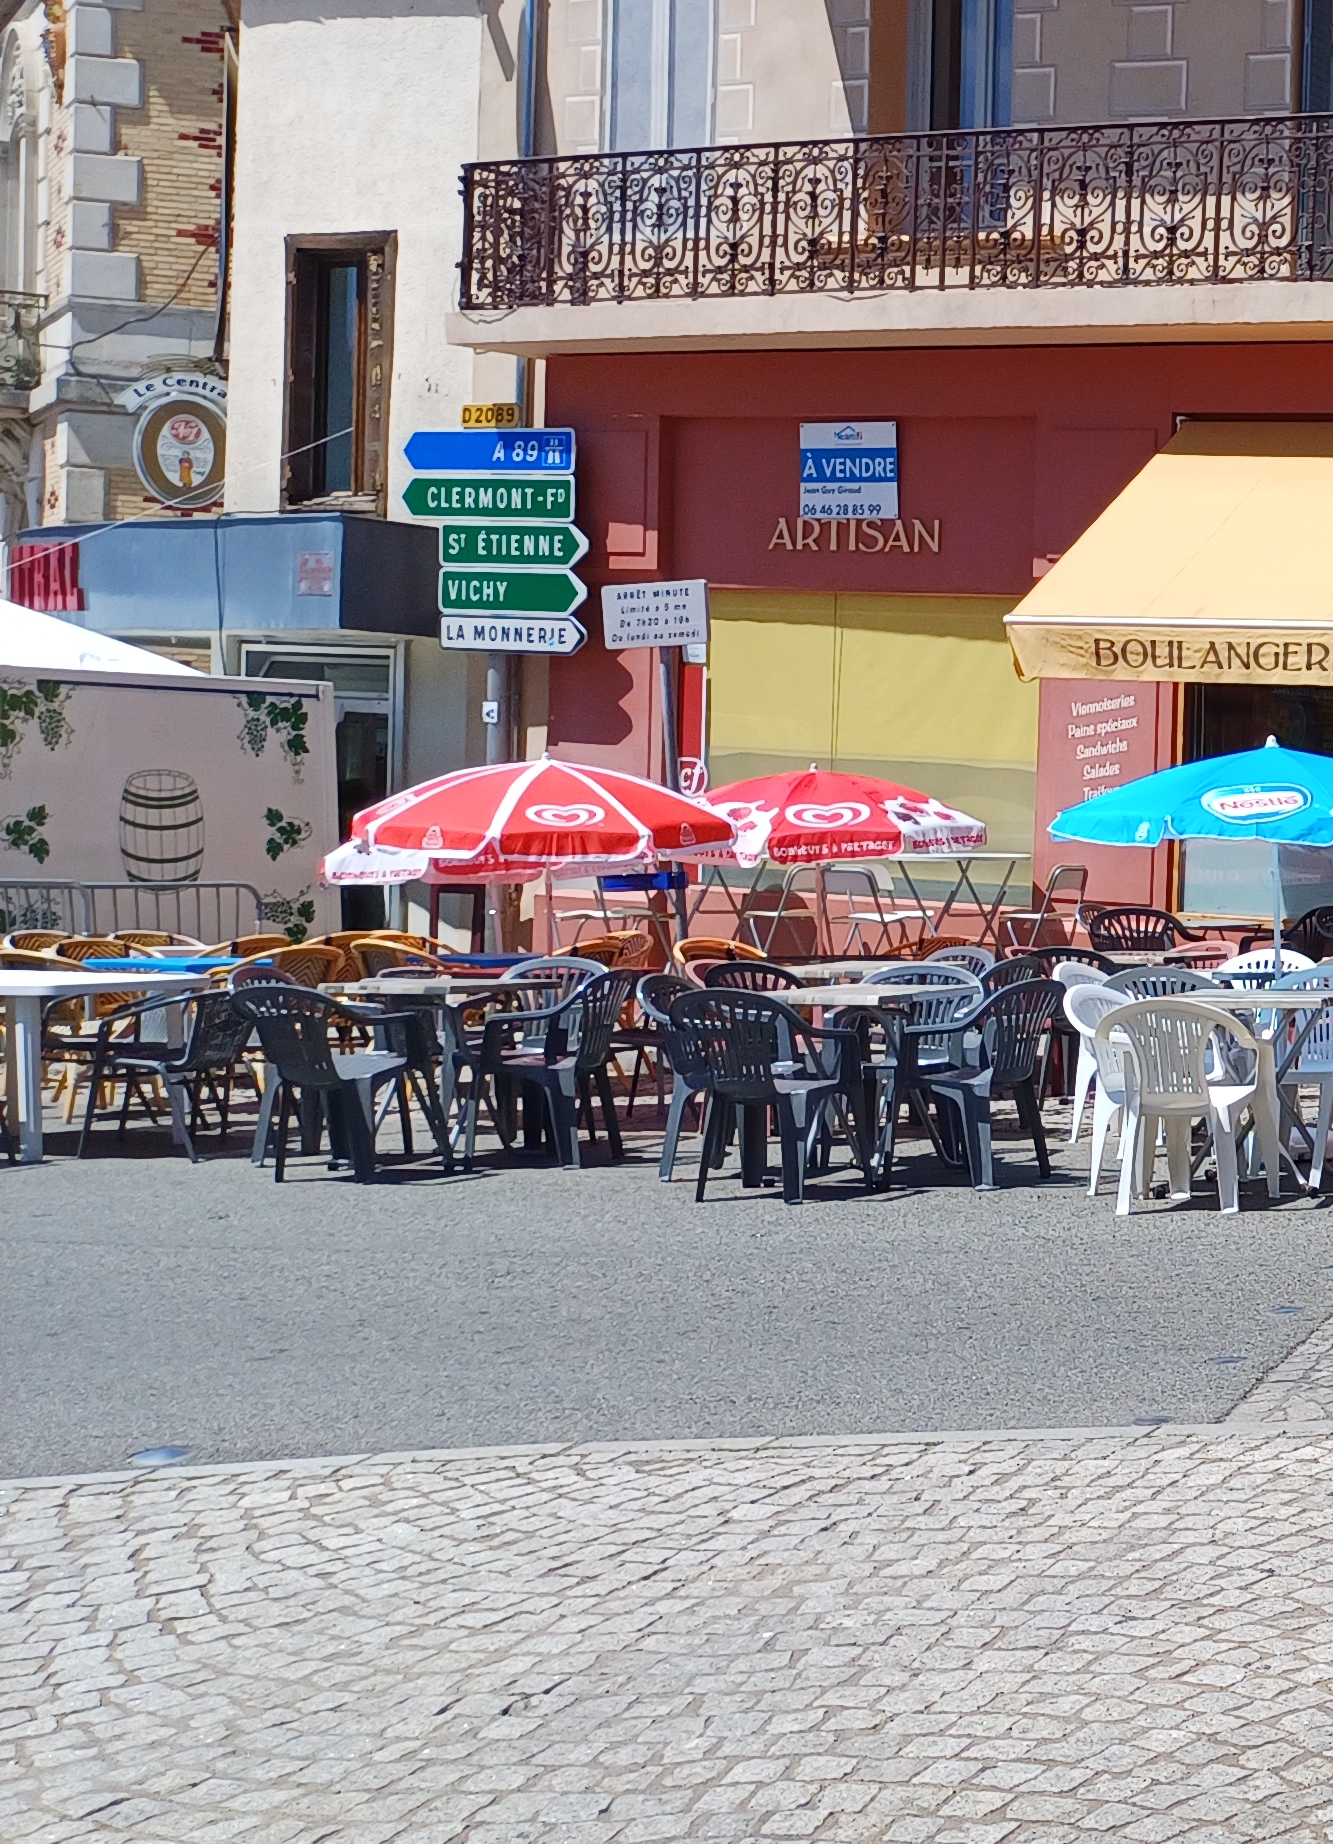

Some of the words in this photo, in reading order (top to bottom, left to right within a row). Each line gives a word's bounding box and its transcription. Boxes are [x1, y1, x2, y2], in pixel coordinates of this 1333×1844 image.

[133, 381, 156, 400] Le
[162, 375, 228, 399] Centra
[492, 440, 505, 462] A
[512, 440, 539, 462] 89
[803, 452, 818, 478] À
[822, 457, 895, 478] VENDRE
[803, 503, 817, 516] 06
[819, 503, 833, 516] 46
[836, 503, 849, 516] 28
[868, 503, 882, 516] 99
[477, 530, 564, 556] ÉTIENNE
[768, 517, 940, 553] ARTISAN
[448, 579, 508, 602] VICHY
[446, 624, 465, 641] LA
[474, 625, 567, 645] MONNERIE
[1071, 694, 1136, 717] Viennoiseries
[1067, 724, 1095, 739] Pains
[1096, 716, 1139, 737] spéciaux
[1082, 761, 1120, 780] Salades
[1082, 785, 1119, 802] Trait
